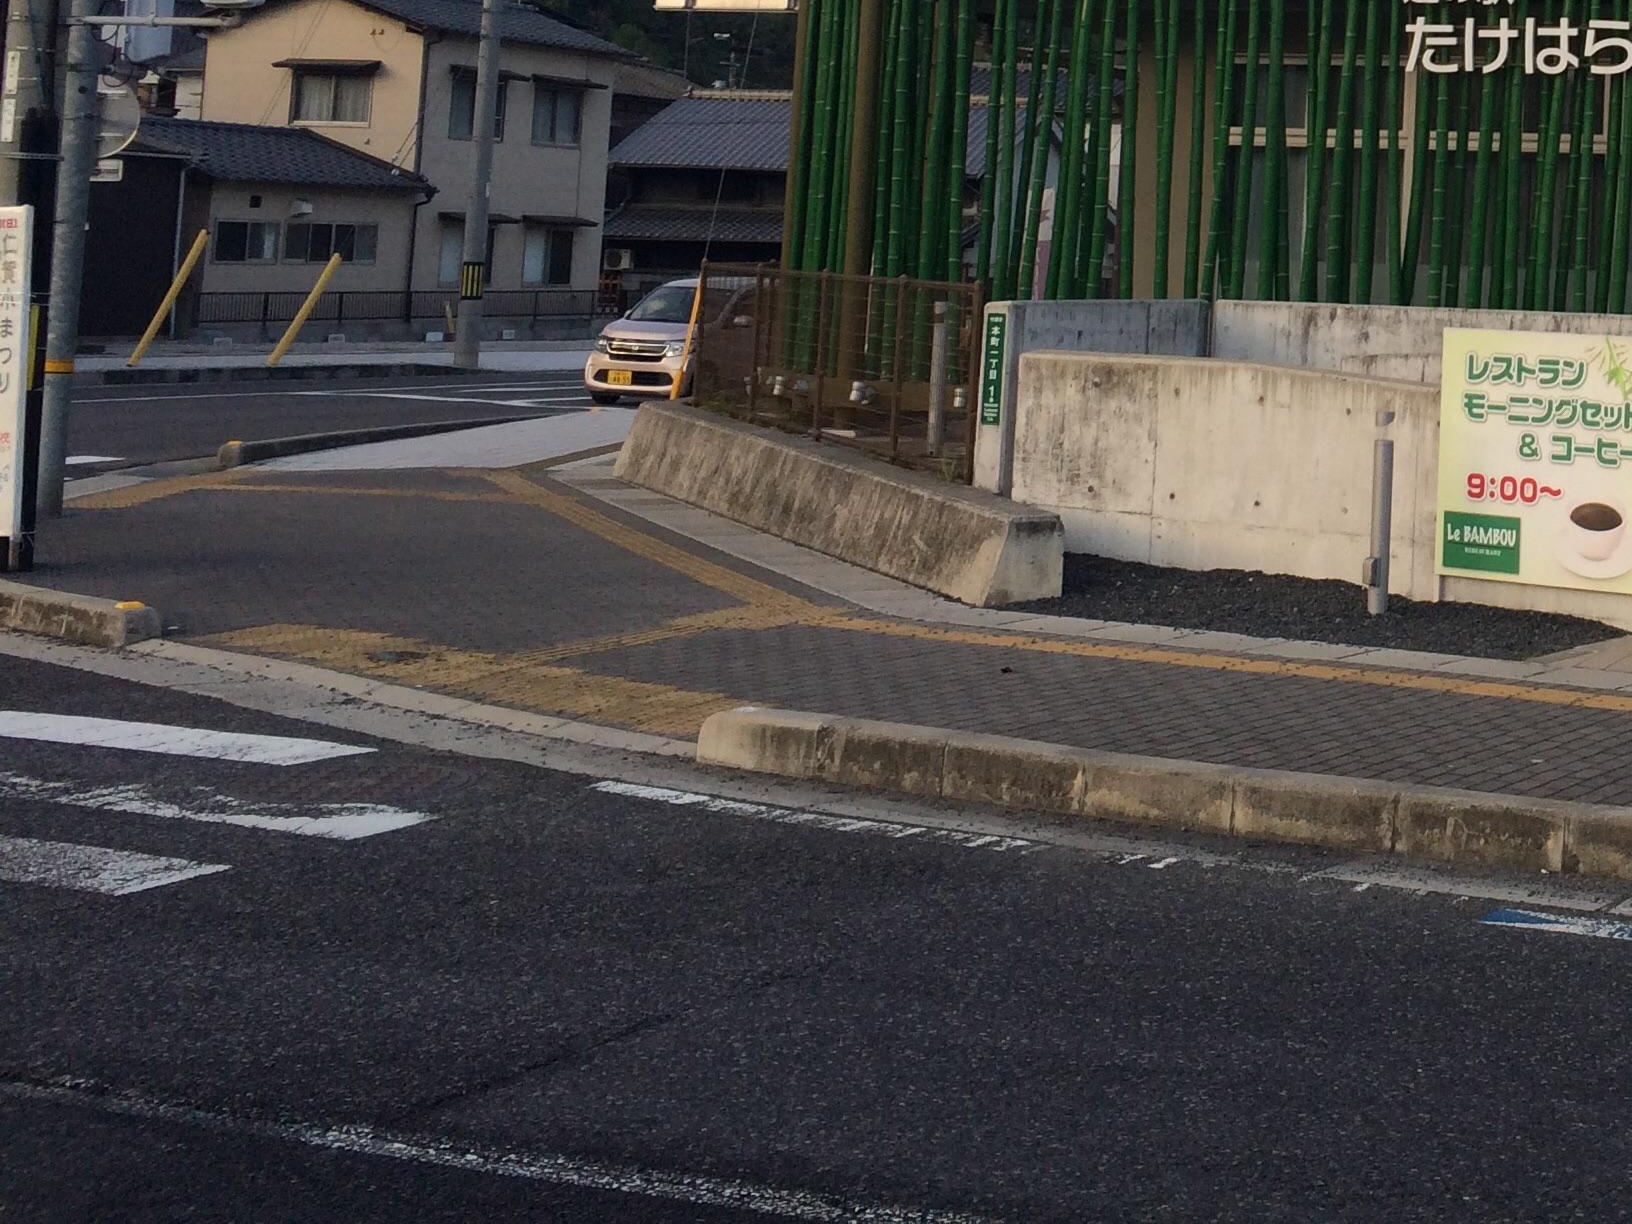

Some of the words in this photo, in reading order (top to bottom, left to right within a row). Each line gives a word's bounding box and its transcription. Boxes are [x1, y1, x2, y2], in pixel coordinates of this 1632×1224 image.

[989, 326, 1001, 380] 本町一丁目
[1467, 353, 1585, 387] レストラン
[1518, 432, 1540, 458] &
[1447, 523, 1461, 542] Le
[1463, 525, 1517, 548] BAMBOU
